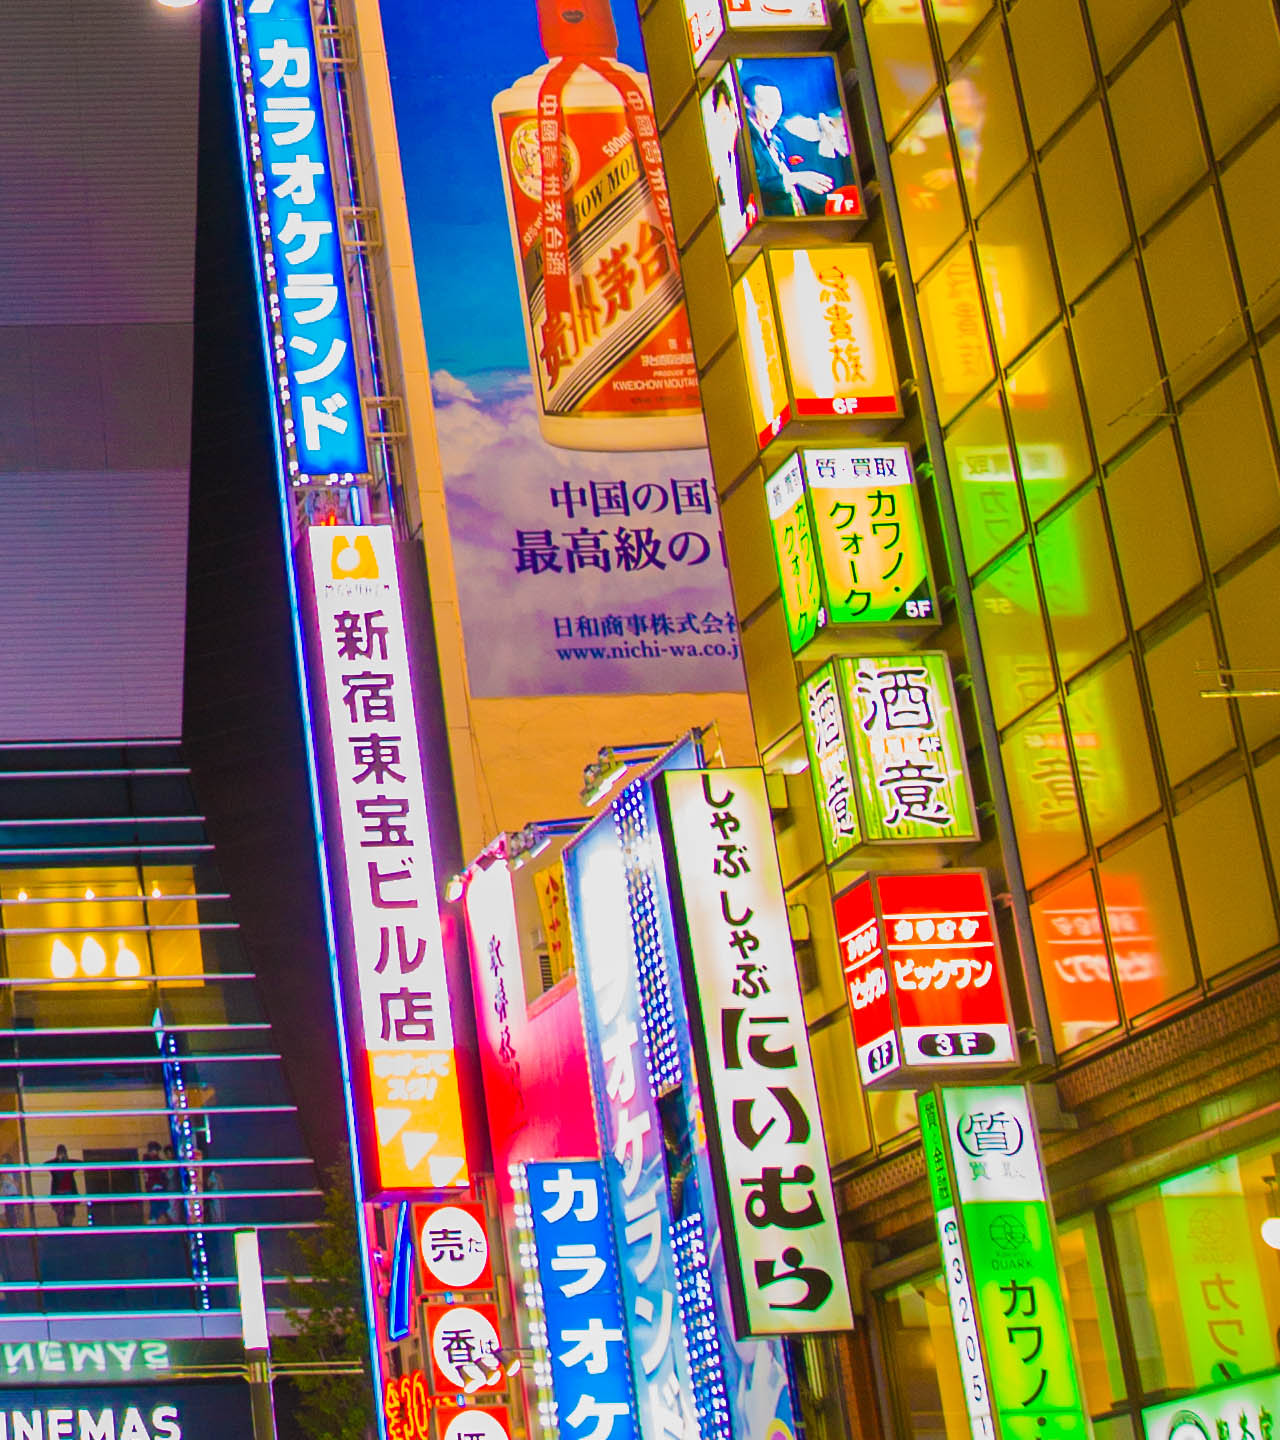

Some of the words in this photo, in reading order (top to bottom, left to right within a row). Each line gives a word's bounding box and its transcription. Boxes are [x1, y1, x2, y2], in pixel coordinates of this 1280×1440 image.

[826, 191, 854, 214] 7F
[259, 38, 349, 452] カラオケランド
[831, 396, 858, 416] 6F
[550, 477, 720, 519] 中国の国
[512, 525, 729, 575] 最高級の
[905, 599, 932, 620] 5F
[332, 609, 438, 1044] 新宿東宝ビル店
[936, 1033, 980, 1055] 3F
[720, 1007, 835, 1314] にいむら
